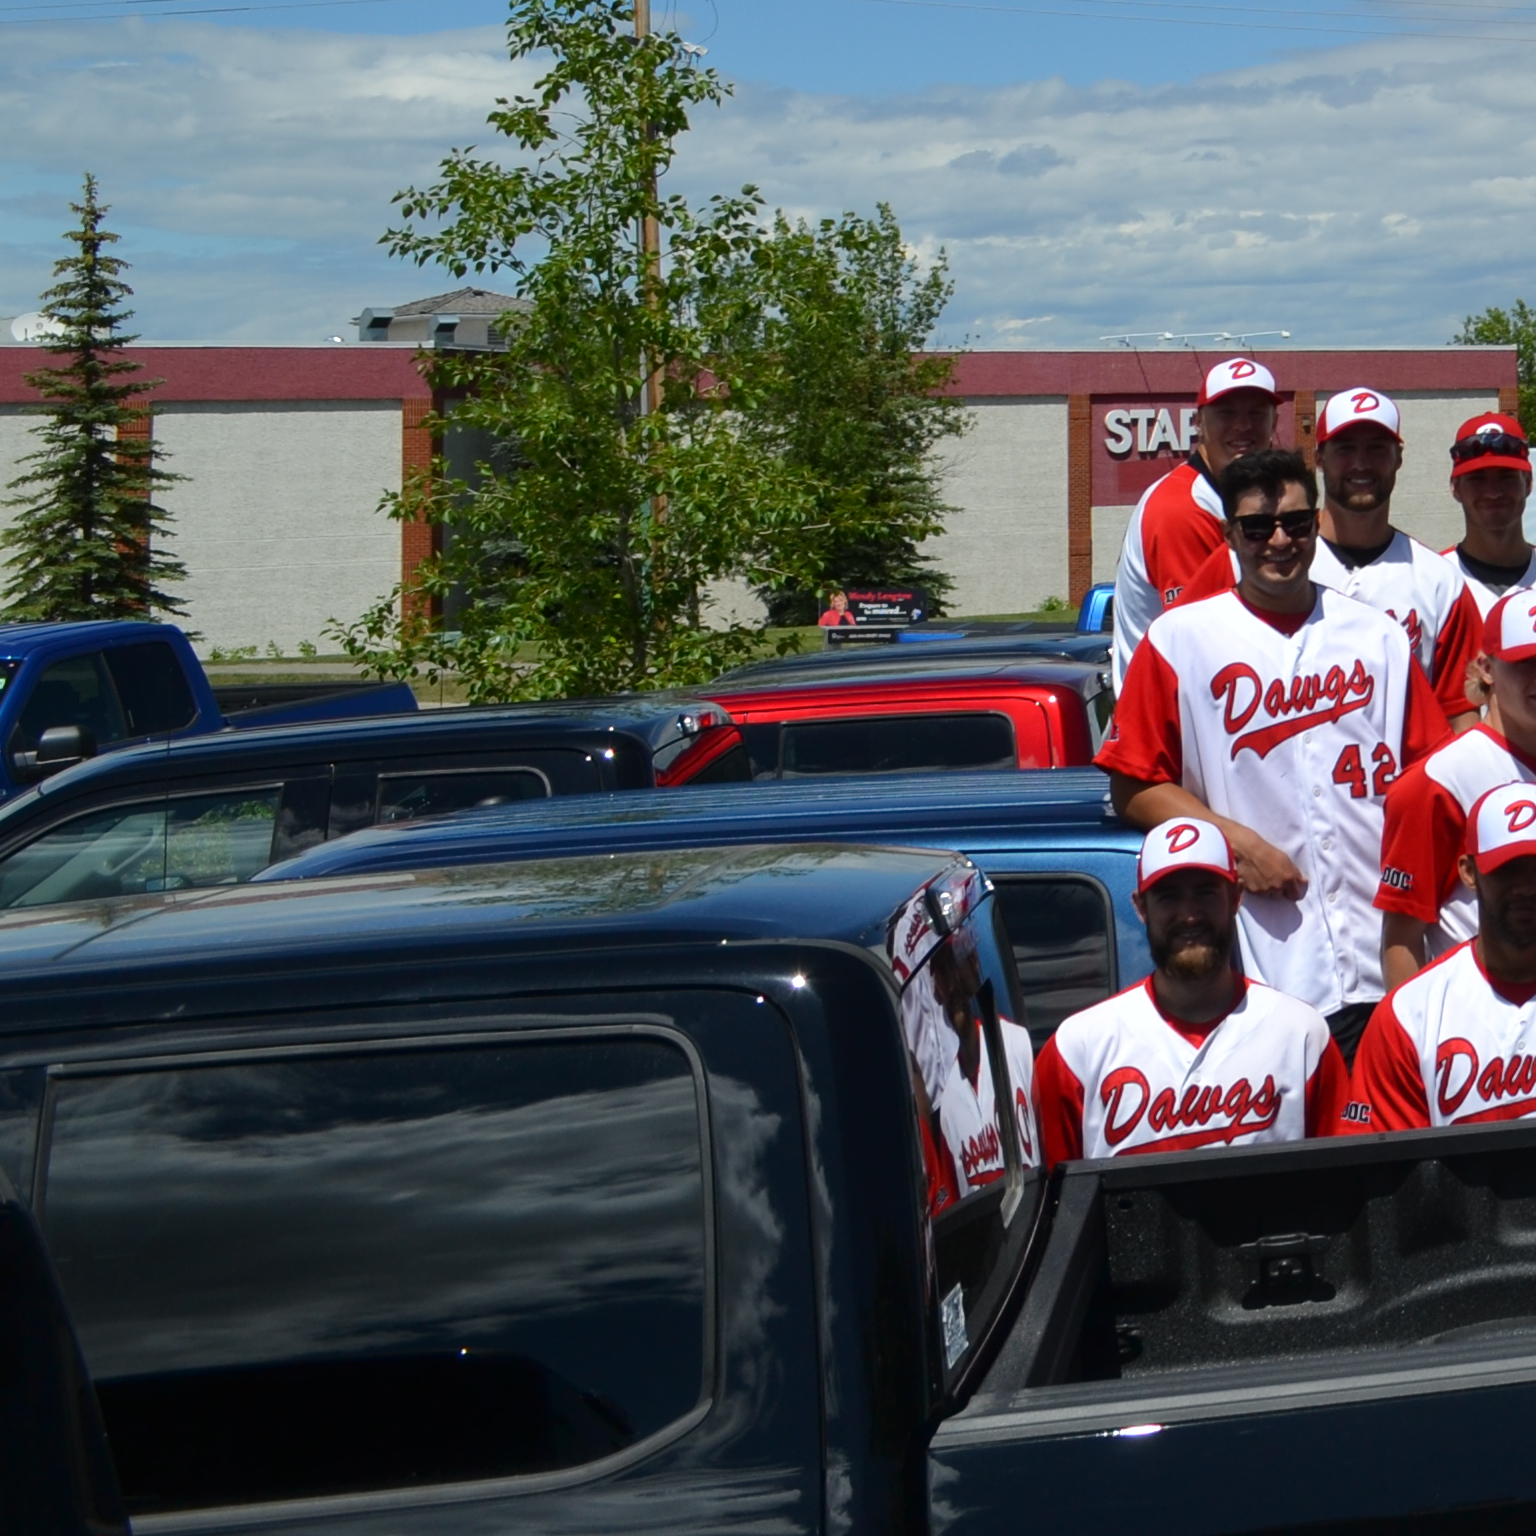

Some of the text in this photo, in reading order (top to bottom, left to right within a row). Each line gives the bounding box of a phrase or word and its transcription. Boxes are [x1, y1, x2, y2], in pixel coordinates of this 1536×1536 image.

[1104, 408, 1199, 454] STAP
[1210, 659, 1375, 734] Dawgs
[1332, 742, 1397, 799] 42
[1101, 1066, 1282, 1146] Dawgs
